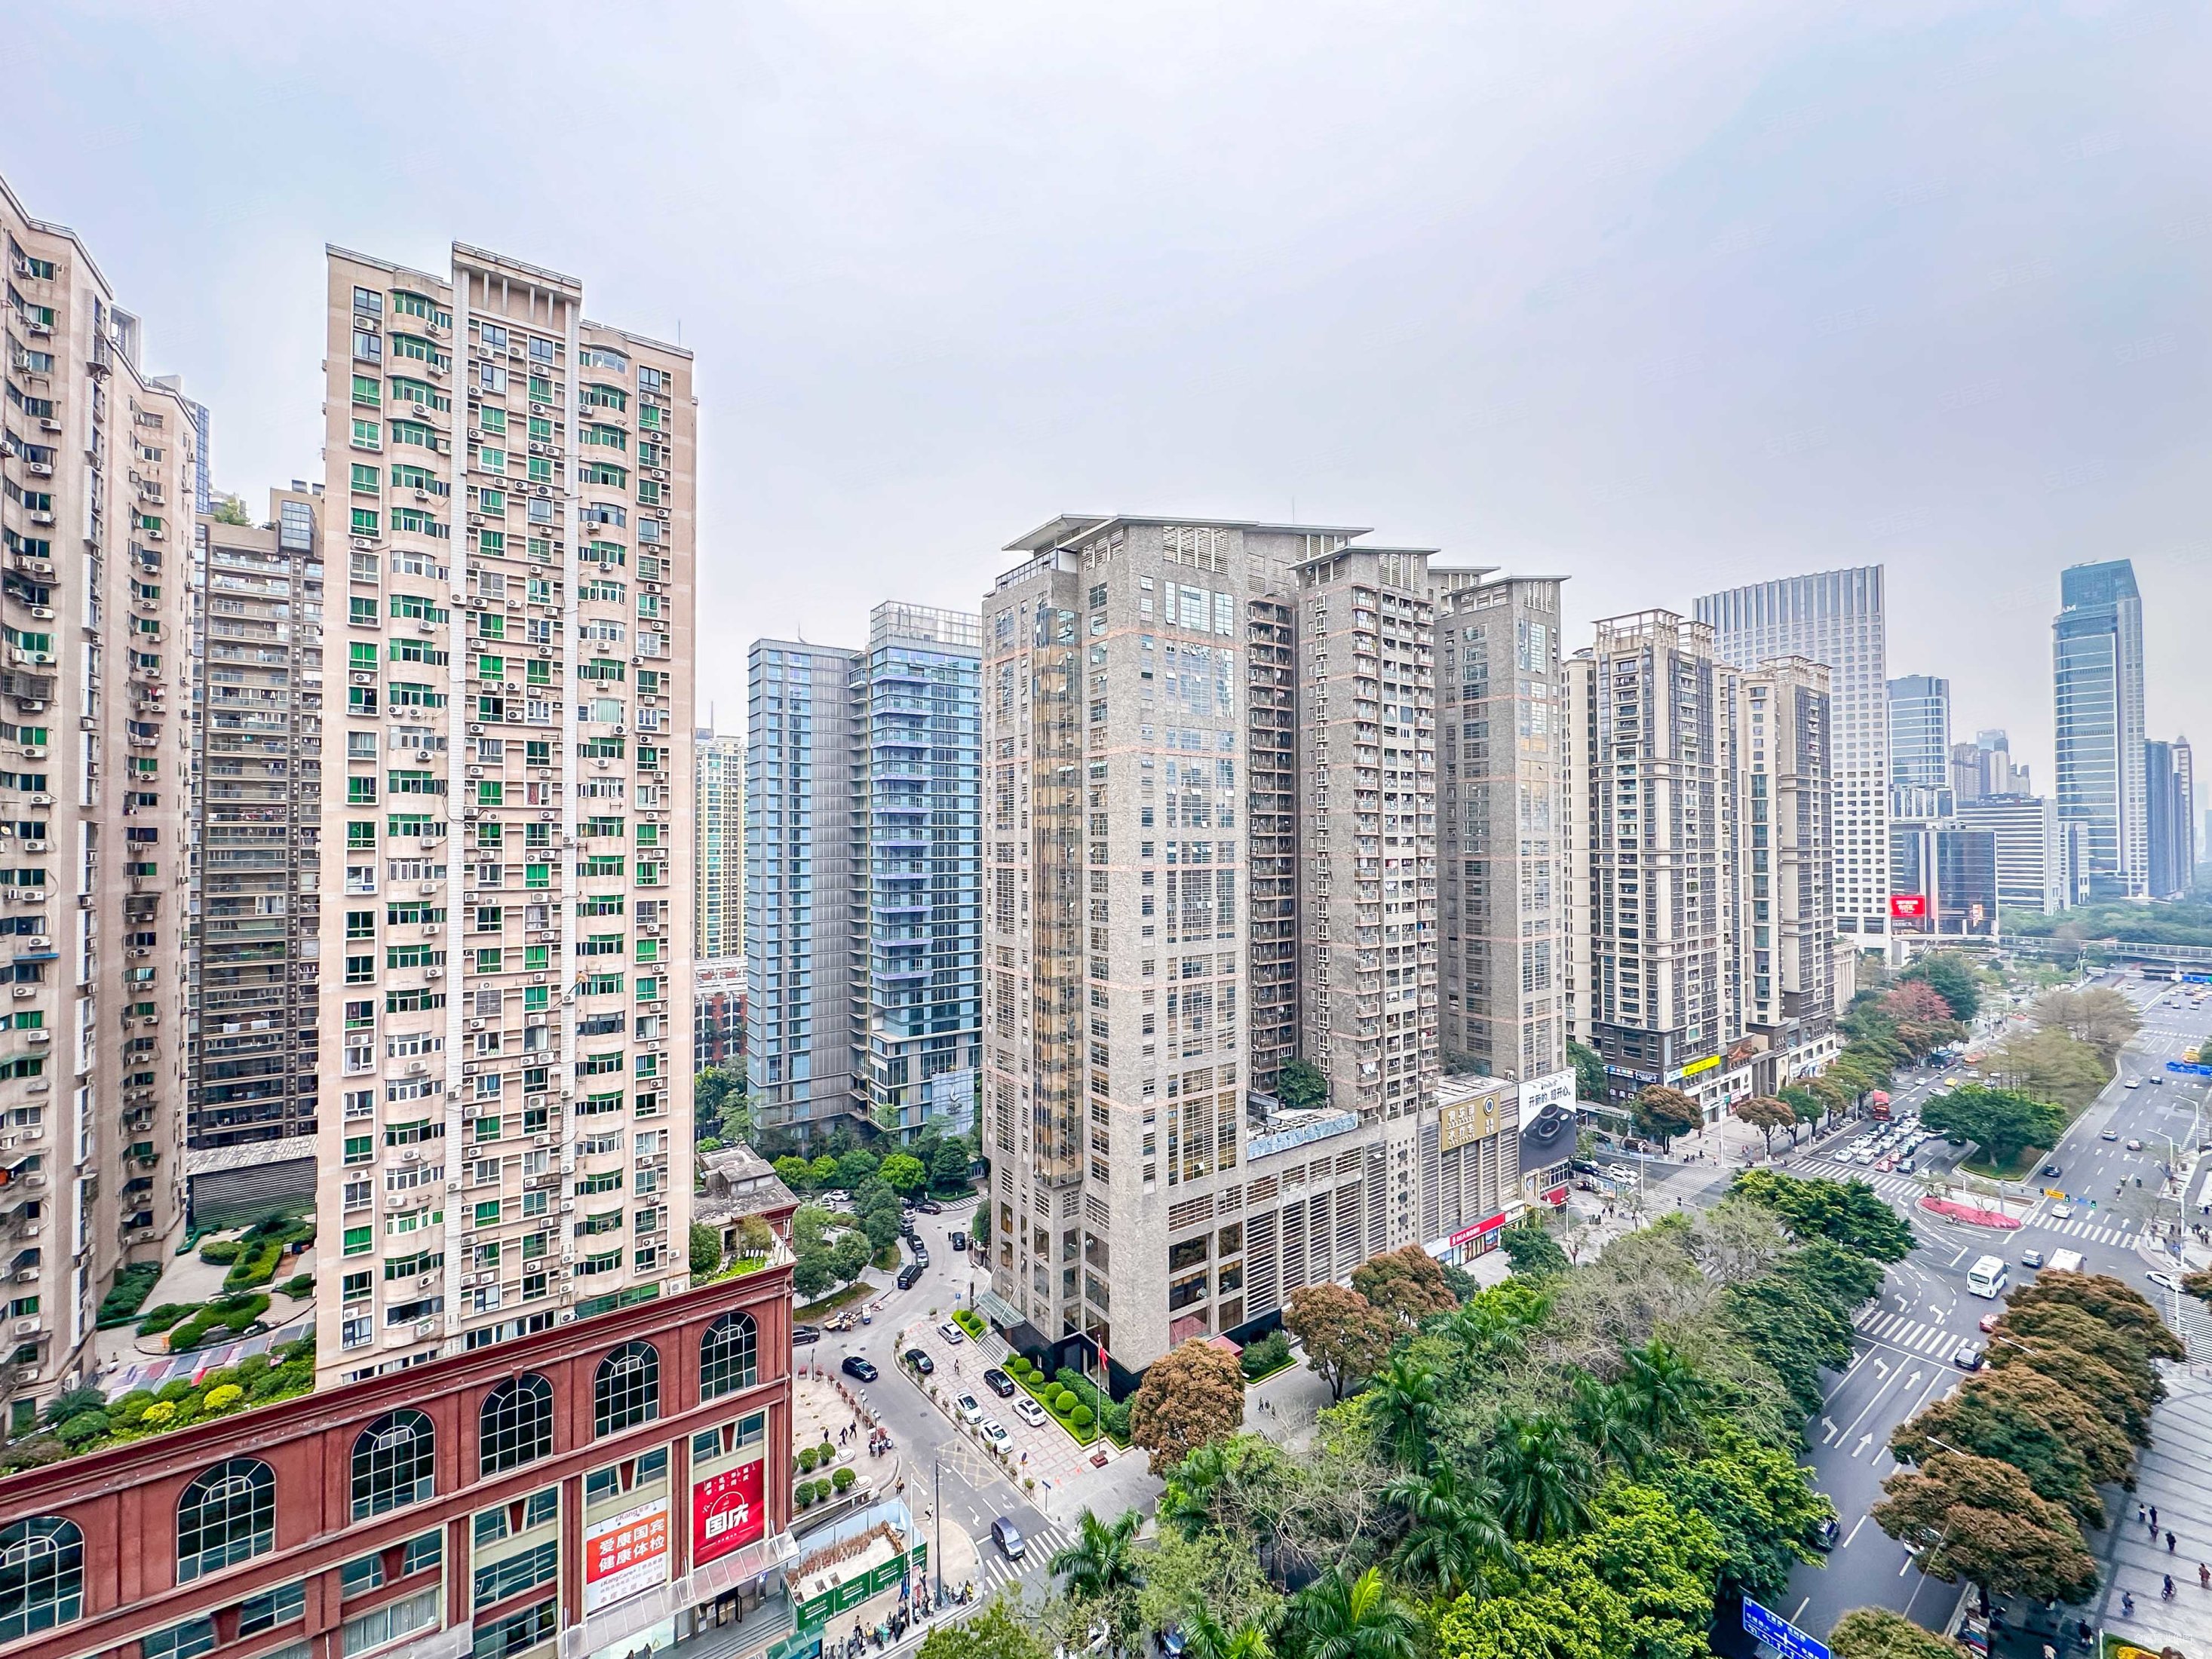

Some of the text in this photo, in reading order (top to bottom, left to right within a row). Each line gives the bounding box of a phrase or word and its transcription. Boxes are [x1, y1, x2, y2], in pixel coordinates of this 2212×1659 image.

[599, 1518, 665, 1556] 爱康国宾
[706, 1503, 749, 1539] 国庆
[598, 1535, 665, 1573] 健康体检
